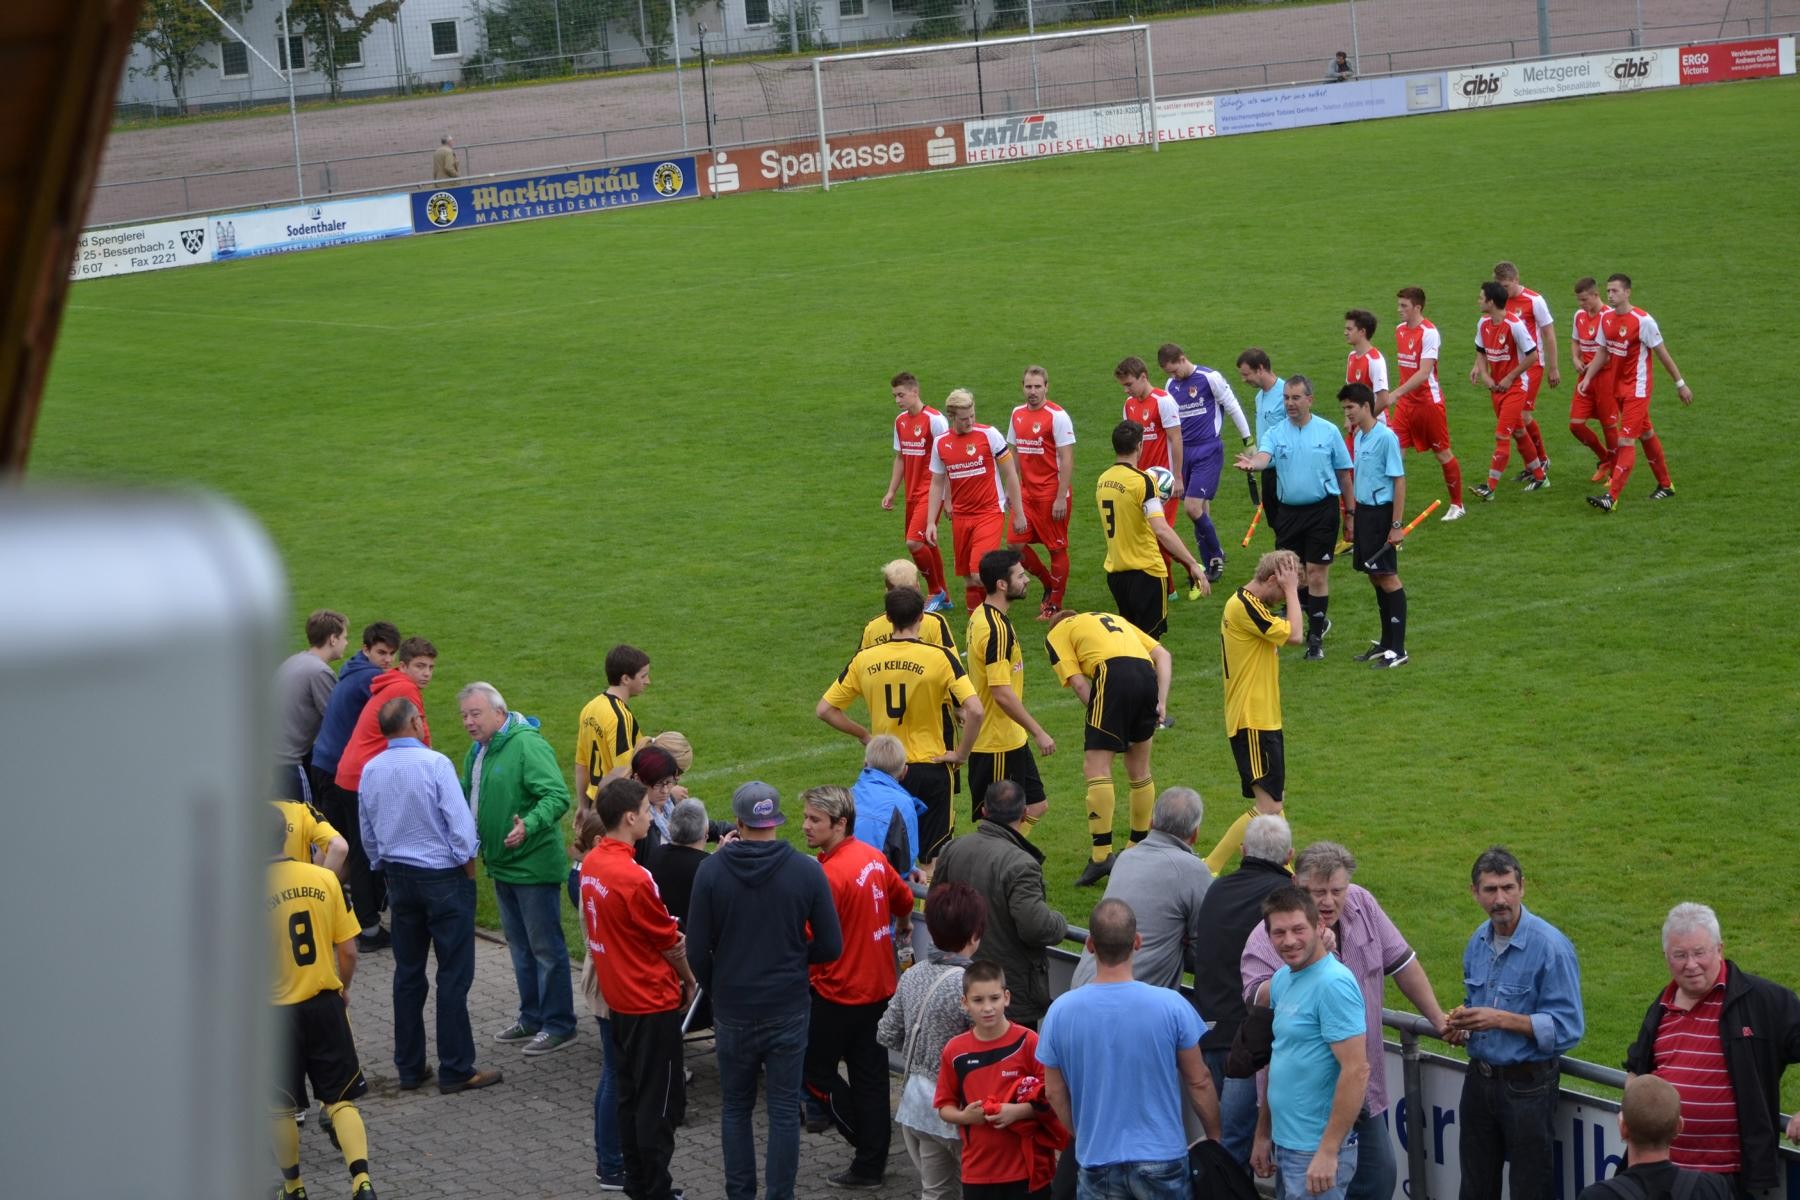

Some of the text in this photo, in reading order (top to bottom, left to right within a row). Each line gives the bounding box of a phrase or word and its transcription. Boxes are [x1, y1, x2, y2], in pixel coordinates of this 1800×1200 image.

[1682, 53, 1709, 66] ERGO
[1522, 60, 1591, 84] Metzgerei
[1682, 65, 1709, 76] Victoria
[1513, 80, 1601, 97] Schlesische Spezialitäten
[968, 118, 1059, 148] SATTLER
[968, 124, 1217, 163] HEIZÖL DIESEL HOLZPELLETS
[472, 167, 640, 209] Martinsbräu
[475, 192, 640, 224] MARKTHEIDENFELD
[287, 219, 348, 237] Sodenthaler
[91, 229, 146, 247] Spenglerei
[103, 242, 165, 258] Bessenbach
[168, 239, 176, 250] 2
[131, 253, 177, 268] Fax 2221
[1104, 480, 1126, 494] KEILBERG
[1102, 499, 1116, 539] 3
[867, 660, 925, 676] TSV KEILBERG
[884, 683, 907, 726] 4
[280, 886, 326, 903] KEILBERG
[288, 910, 317, 967] 8
